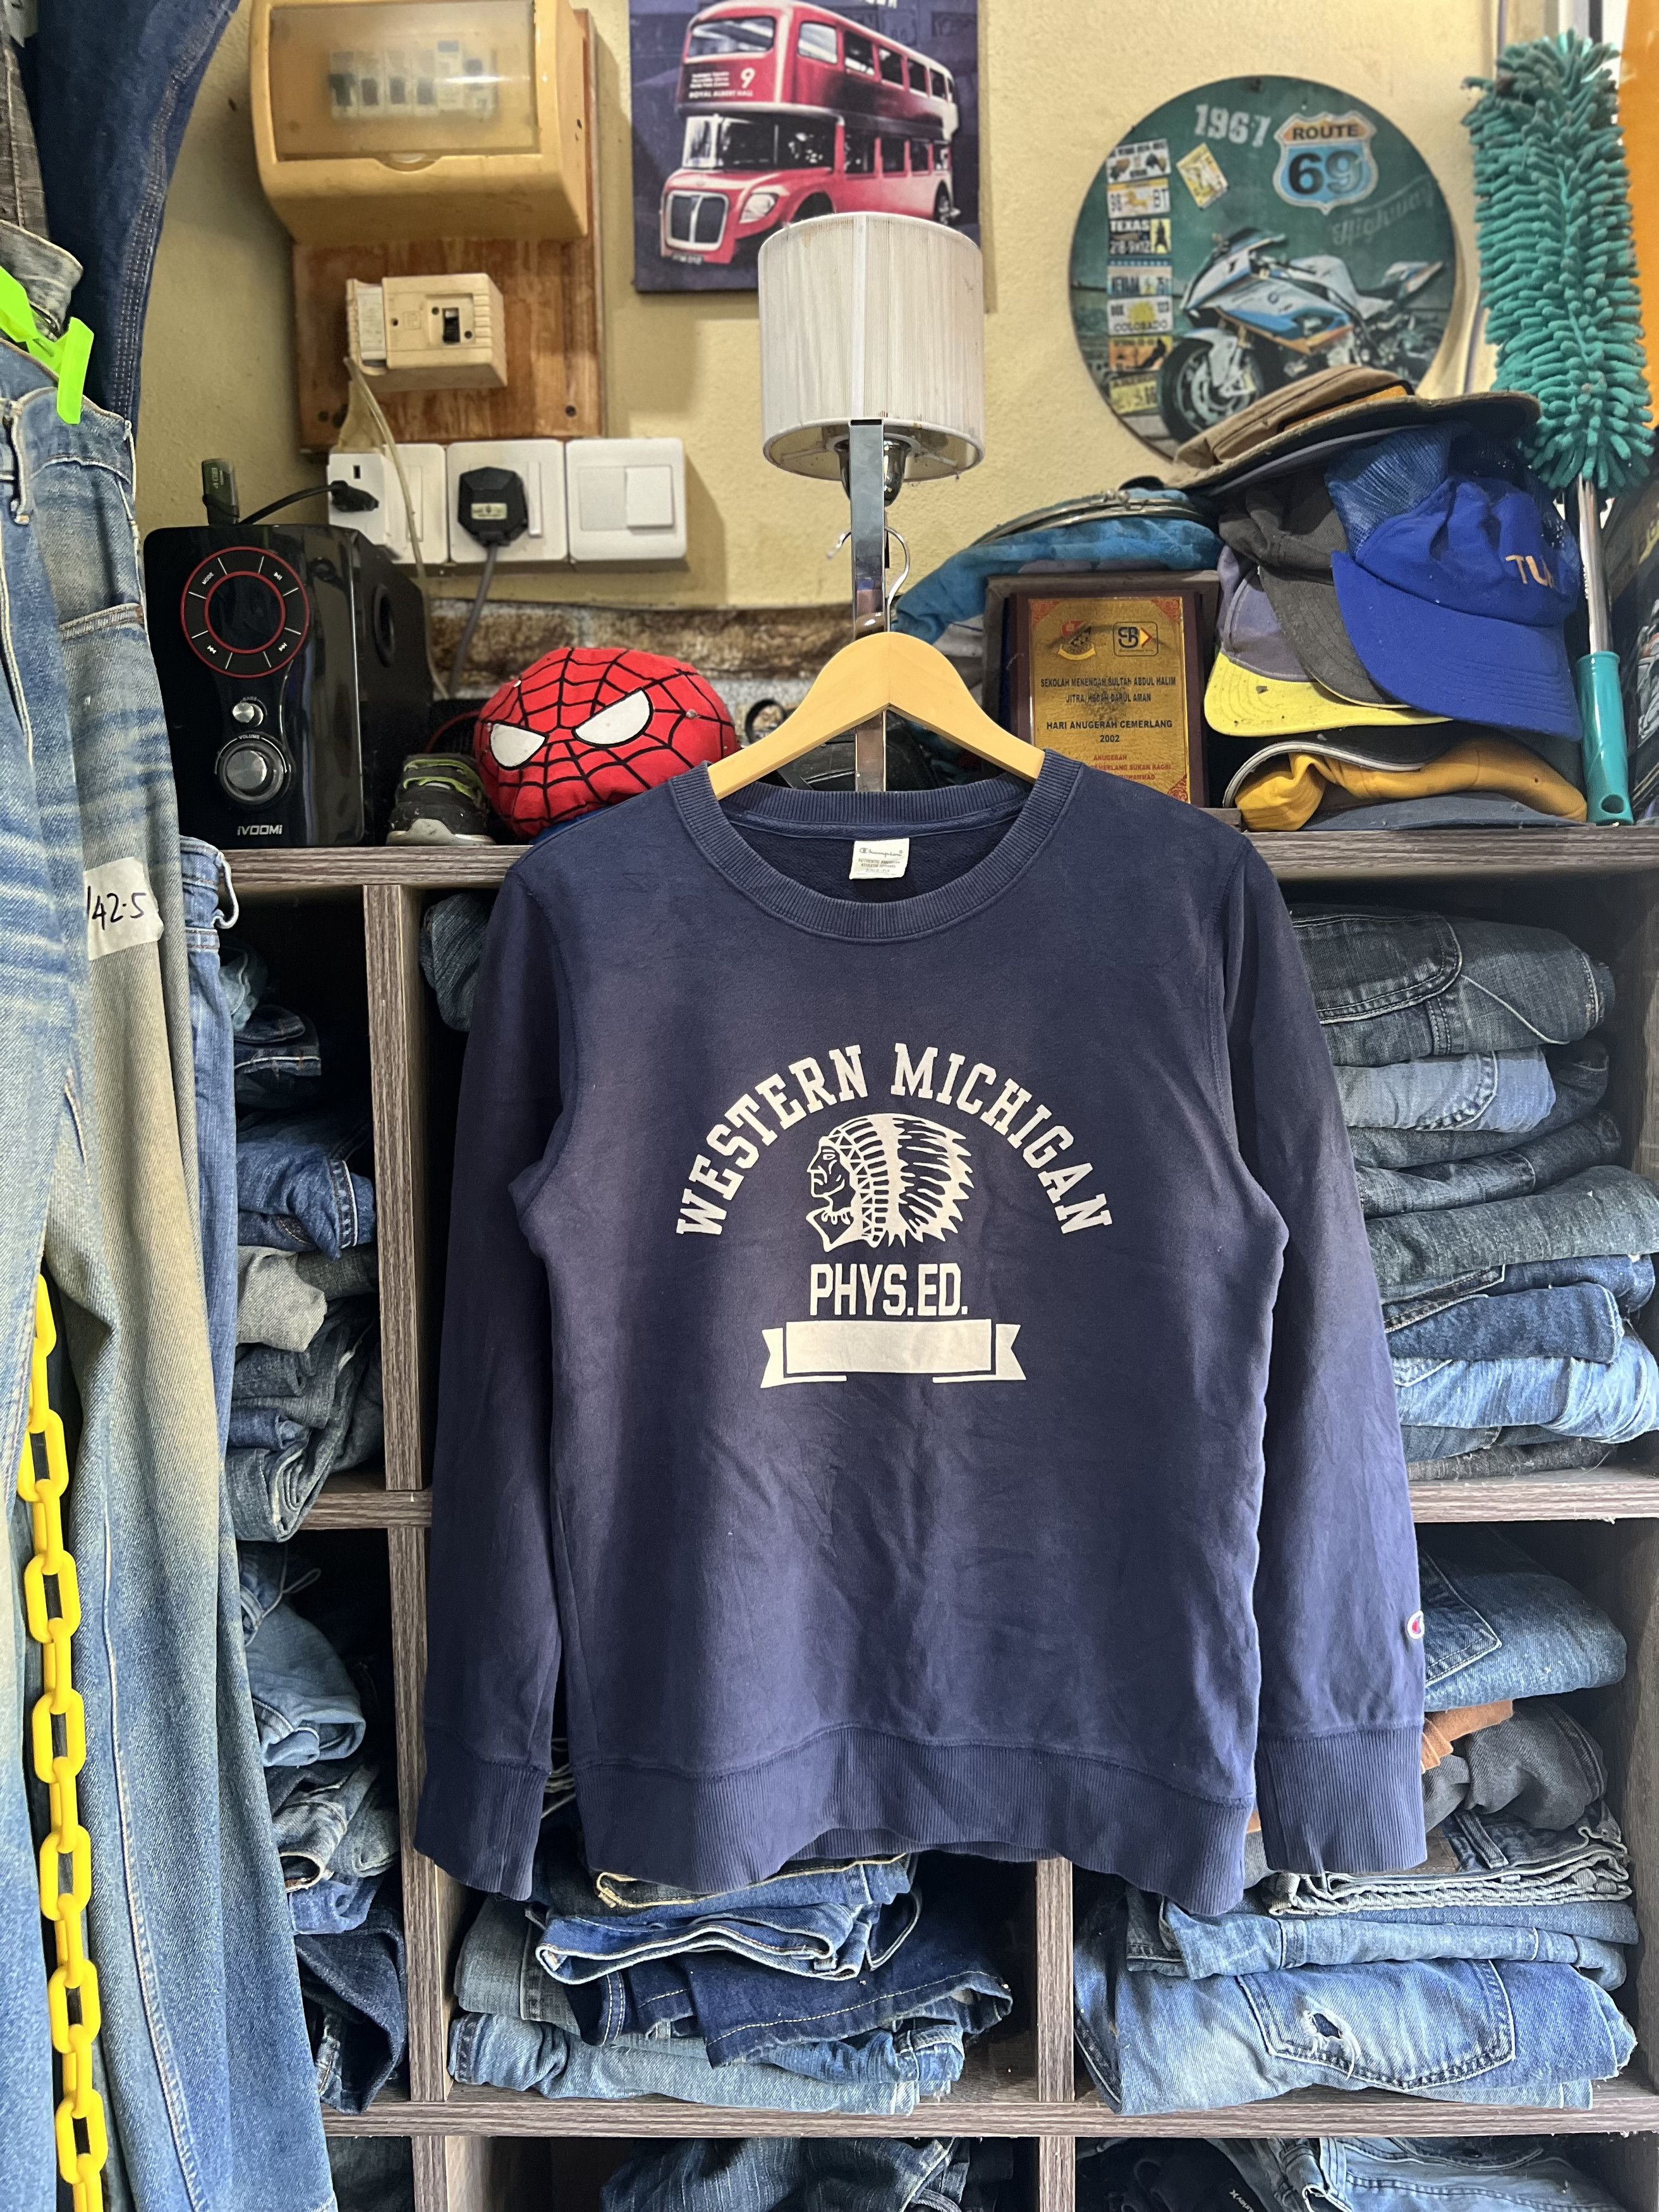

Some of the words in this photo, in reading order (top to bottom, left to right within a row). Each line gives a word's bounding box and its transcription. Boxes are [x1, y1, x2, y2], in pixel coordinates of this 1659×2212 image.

[740, 68, 755, 88] 9
[1194, 104, 1272, 148] 1967
[1292, 123, 1359, 141] ROUTE
[1288, 150, 1363, 195] 69
[1110, 219, 1150, 233] TEXAS
[1114, 319, 1168, 333] COLORADO
[202, 572, 214, 585] MODE
[1041, 678, 1069, 688] SEKOLAH
[1134, 677, 1155, 686] ABDUL
[1156, 676, 1176, 686] HALIM
[1110, 693, 1131, 702] DARUL
[1133, 693, 1151, 702] AMAN
[1070, 720, 1117, 729] ANUGERAH
[1120, 720, 1173, 728] CEMERLANG
[676, 1044, 868, 1236] WESTERN
[890, 1042, 1113, 1234] MICHIGAN
